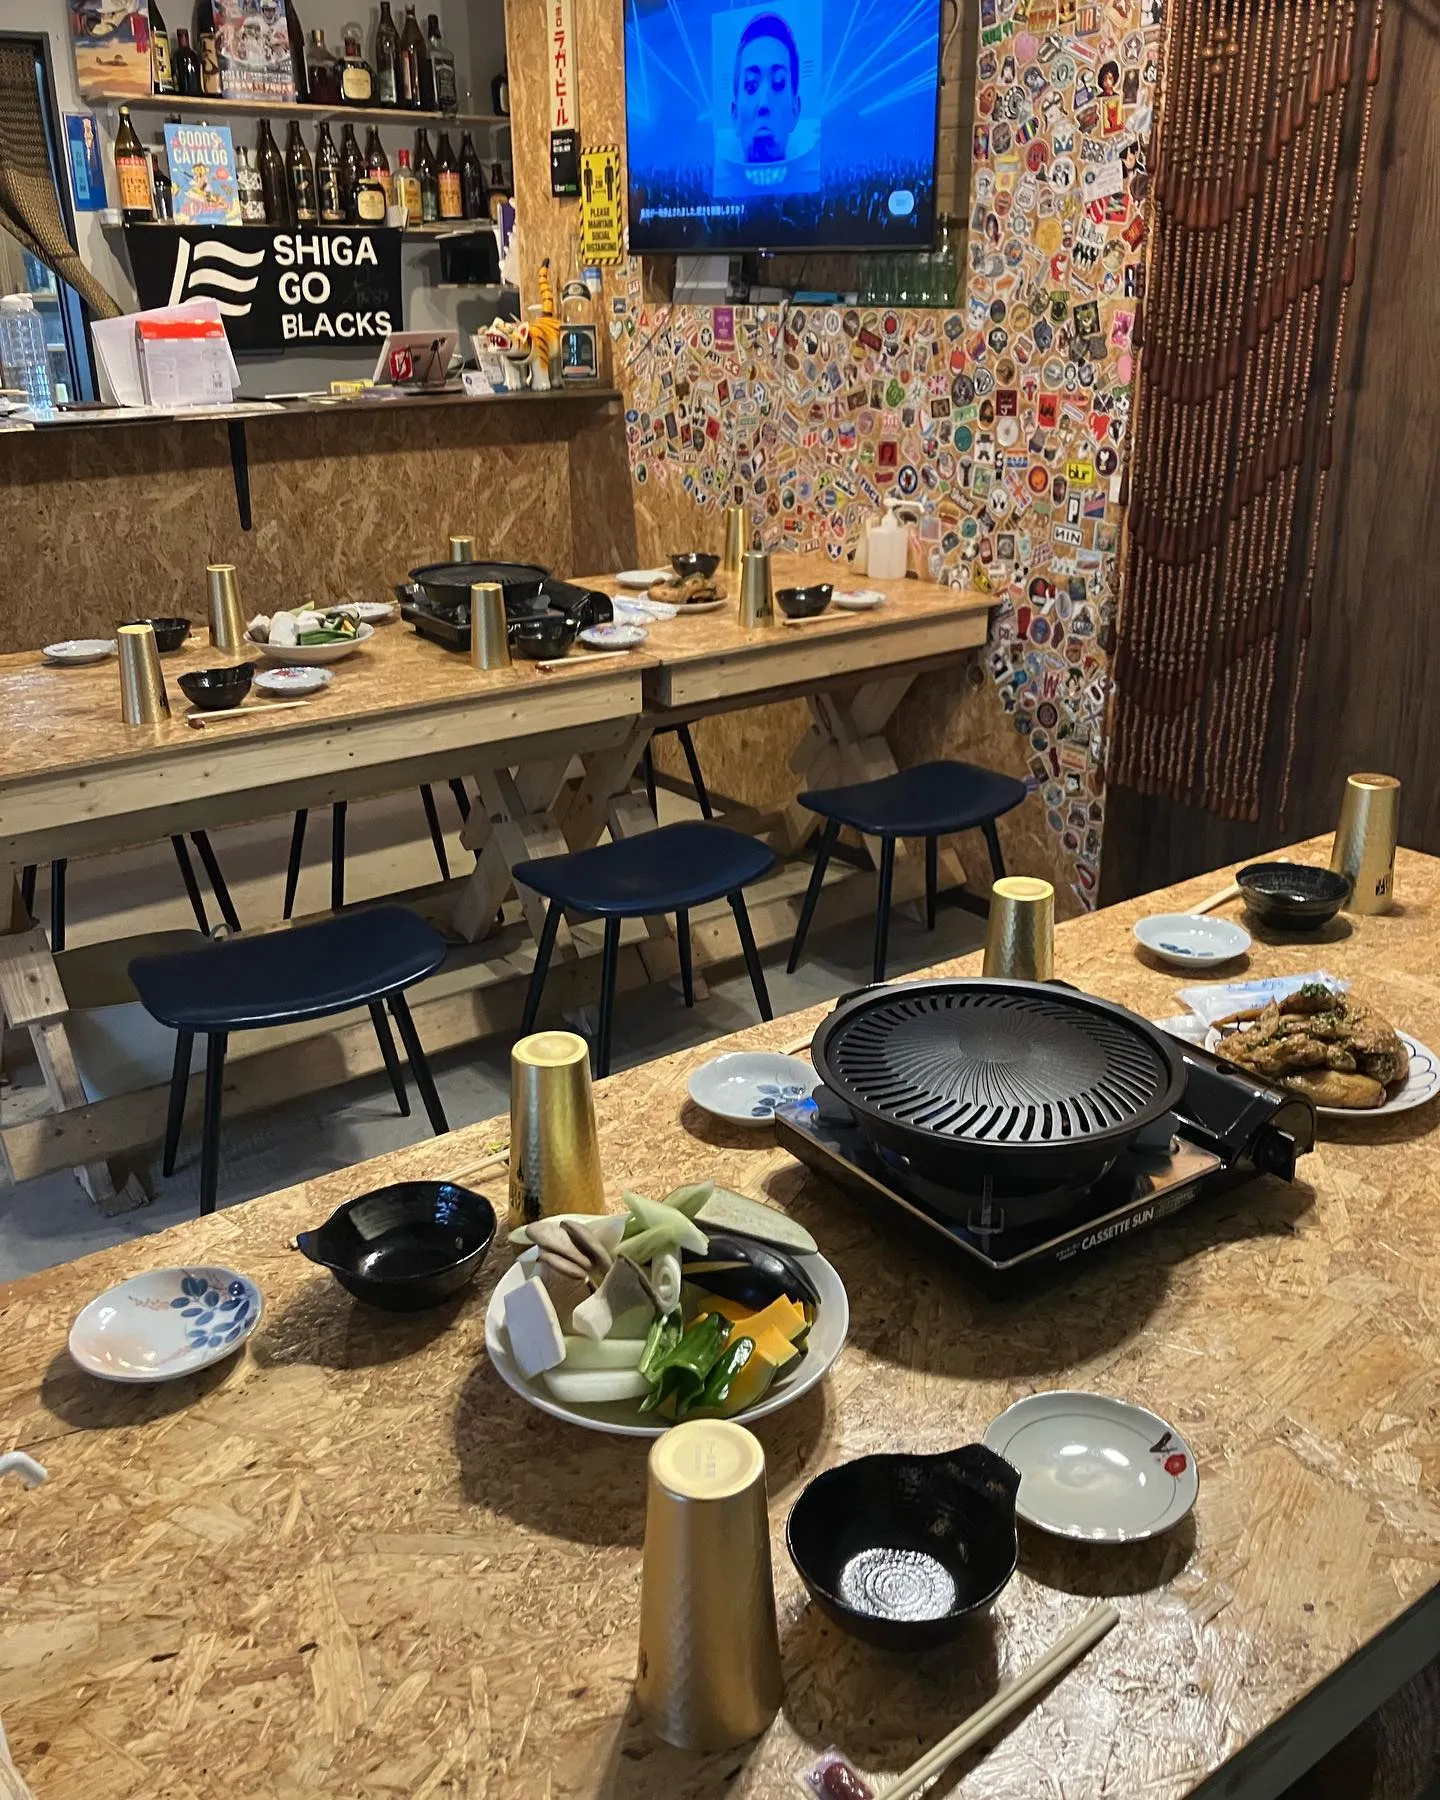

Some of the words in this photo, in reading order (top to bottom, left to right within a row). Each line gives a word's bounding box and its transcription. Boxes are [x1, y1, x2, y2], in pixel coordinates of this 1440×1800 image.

[178, 130, 219, 147] GOODS
[173, 149, 228, 165] CATALOG
[273, 234, 378, 266] SHIGA
[278, 271, 331, 306] GO
[281, 311, 393, 340] BLACKS
[1068, 464, 1090, 480] blur
[1081, 1219, 1131, 1250] CASSETTE
[1132, 1206, 1155, 1228] SUN
